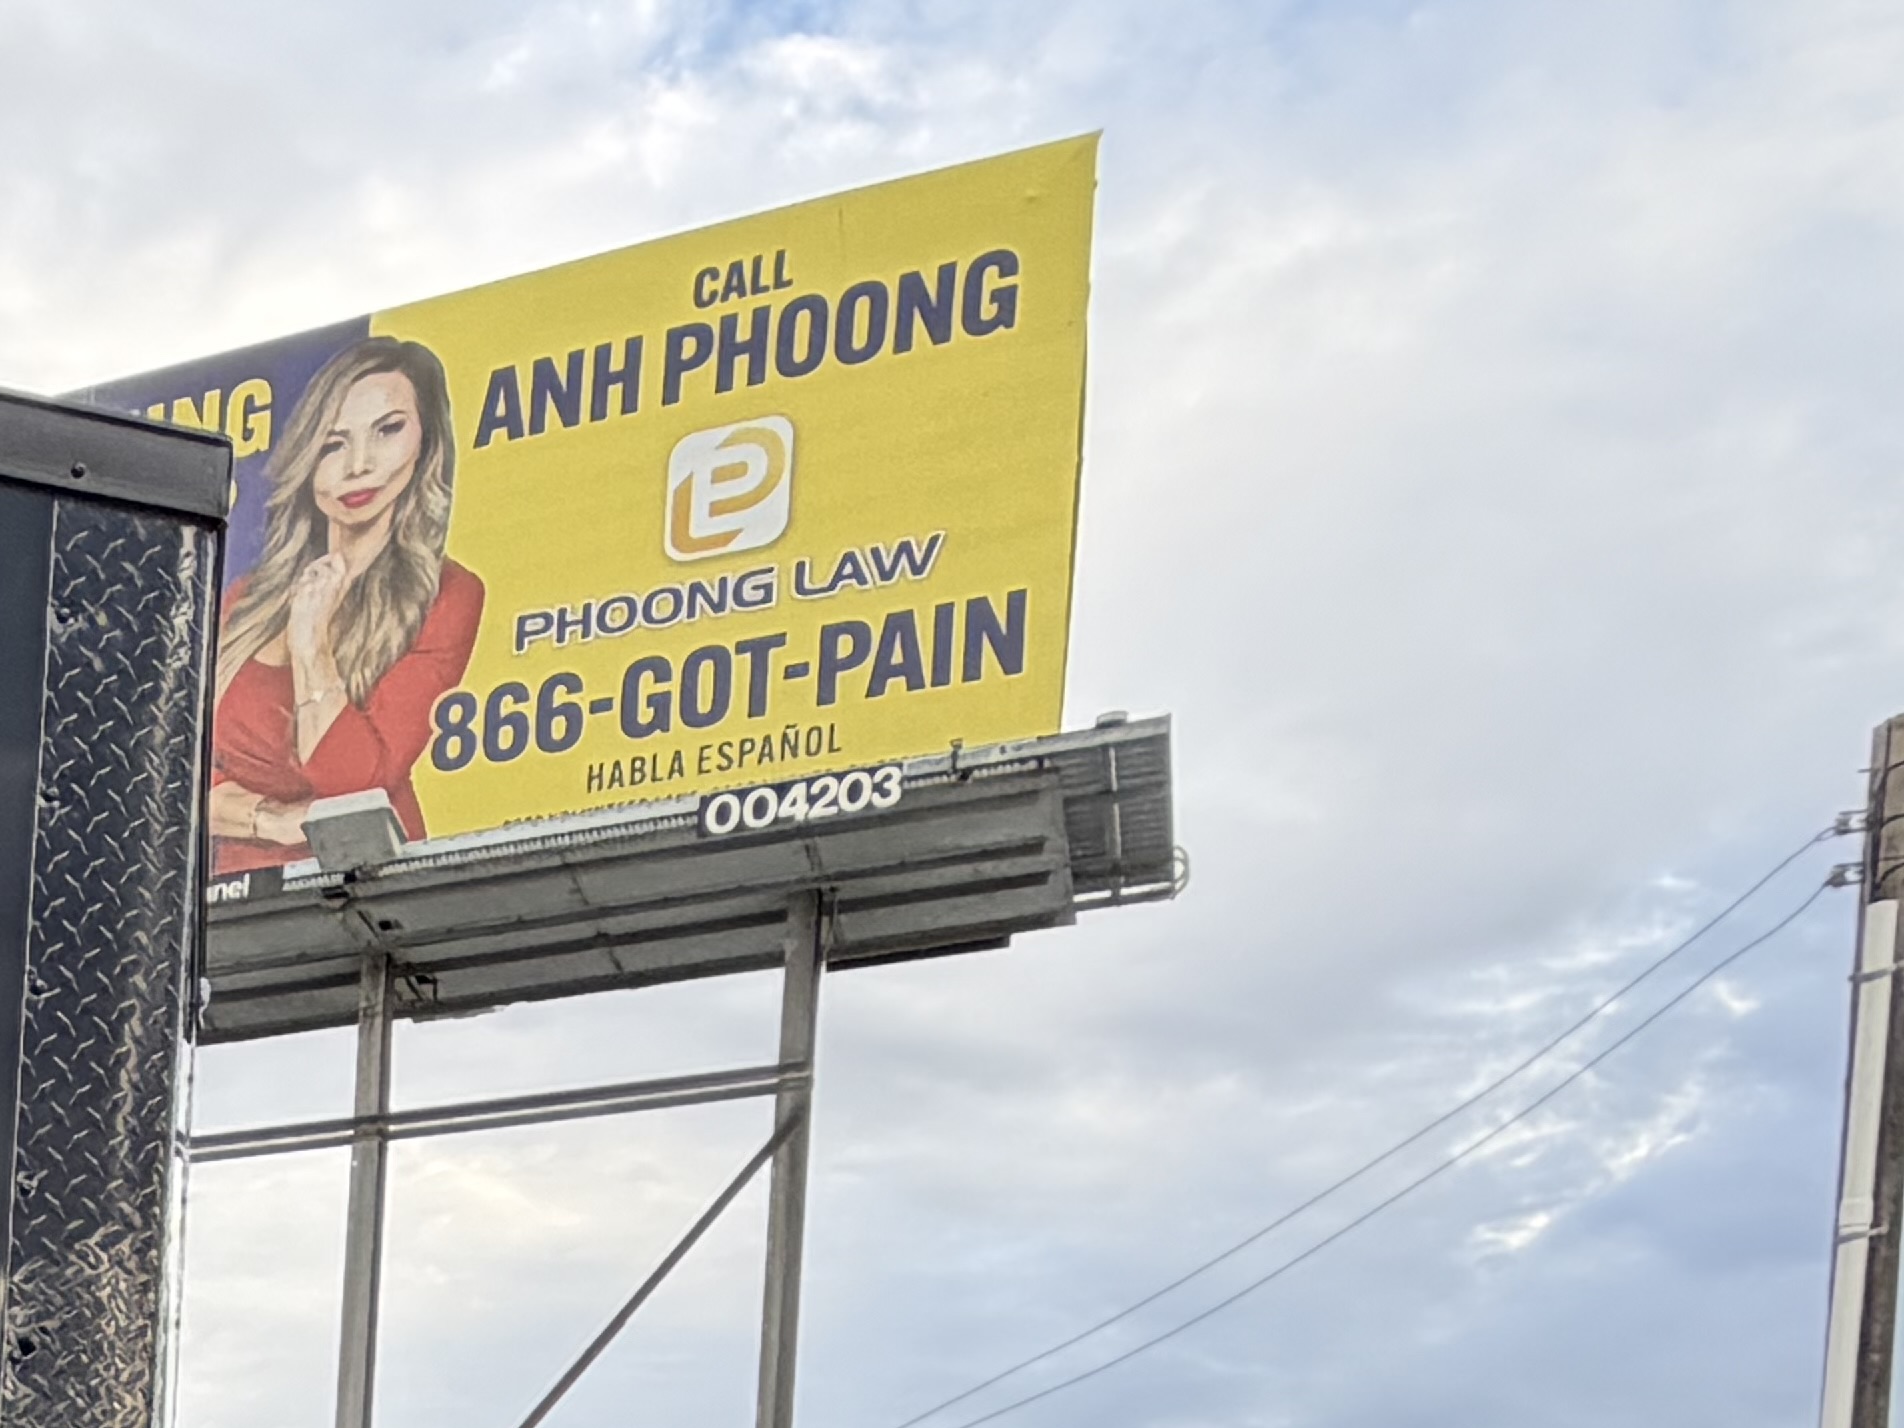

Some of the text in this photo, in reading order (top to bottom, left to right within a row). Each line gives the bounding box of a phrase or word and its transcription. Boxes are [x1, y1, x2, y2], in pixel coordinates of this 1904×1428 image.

[693, 248, 793, 308] CALL
[473, 248, 1019, 449] ANH PHOONG
[514, 531, 944, 653] PHOONG LAW
[430, 589, 1028, 772] 866-GOT-PAIN
[587, 722, 842, 794] HABLA ESPAÑOL
[704, 766, 902, 835] 004203
